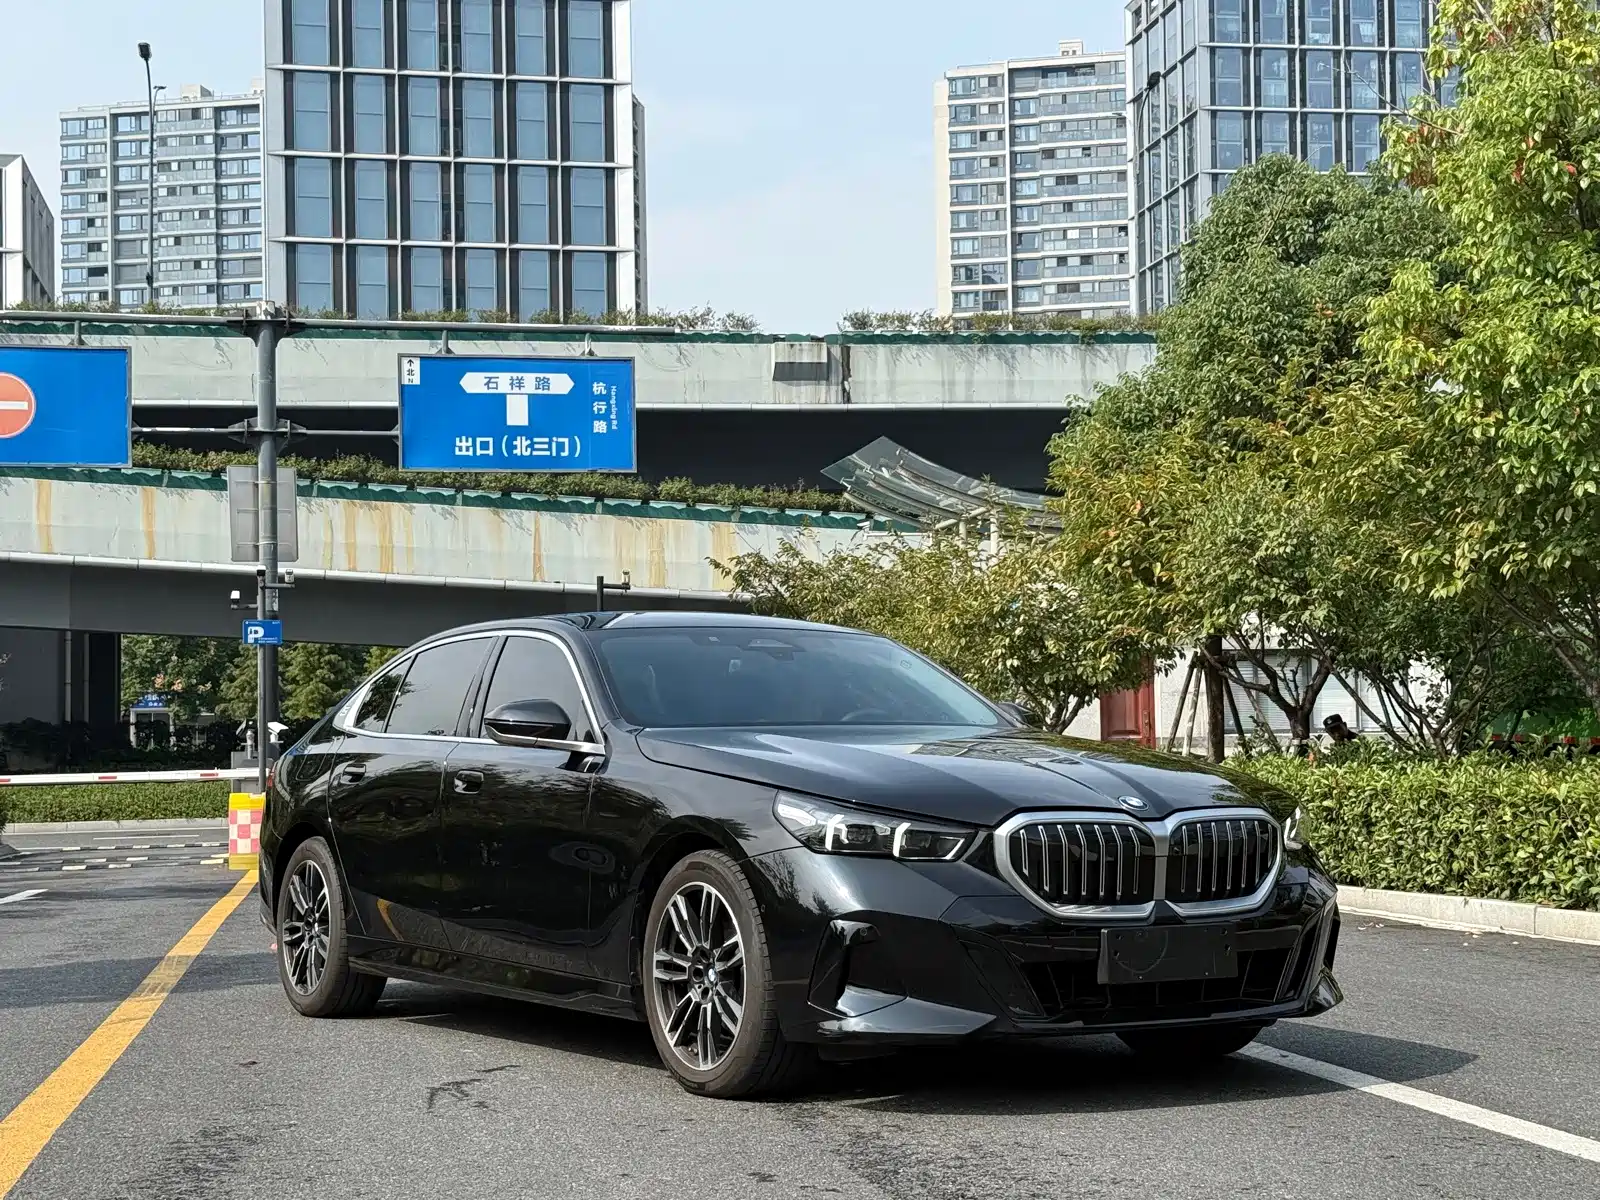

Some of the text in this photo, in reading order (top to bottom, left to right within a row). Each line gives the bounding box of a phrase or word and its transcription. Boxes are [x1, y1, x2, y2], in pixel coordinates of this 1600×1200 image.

[406, 368, 415, 376] 北
[484, 376, 551, 391] 石祥路
[592, 381, 607, 434] 杭行路
